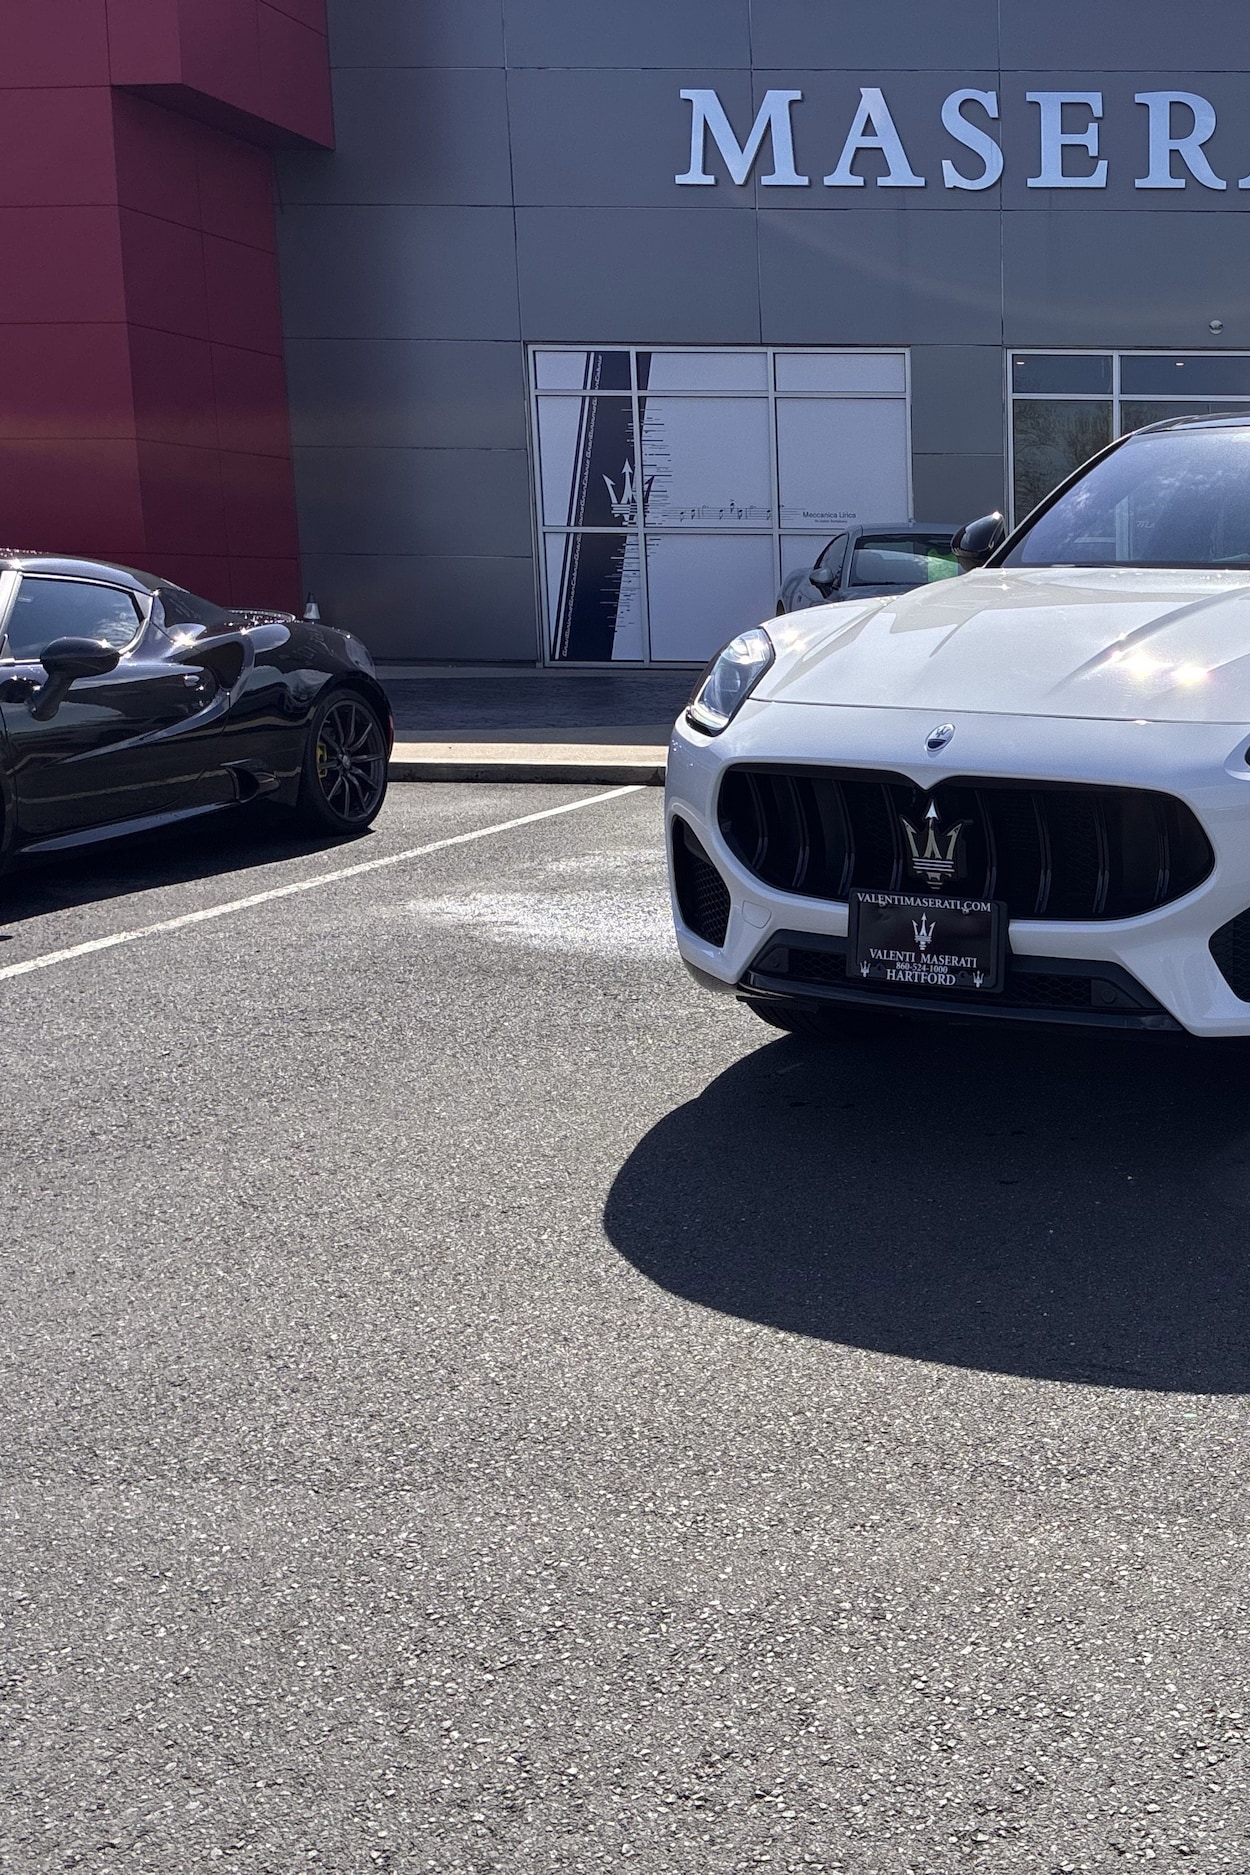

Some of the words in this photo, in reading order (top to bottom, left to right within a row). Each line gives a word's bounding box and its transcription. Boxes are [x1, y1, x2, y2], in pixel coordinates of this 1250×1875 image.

[857, 892, 992, 913] VALENTIMASERATI.COM
[869, 948, 916, 962] VALENTI
[920, 953, 978, 969] MASERATI
[895, 962, 948, 974] 860-524-1000
[886, 968, 956, 986] HARTFORD
